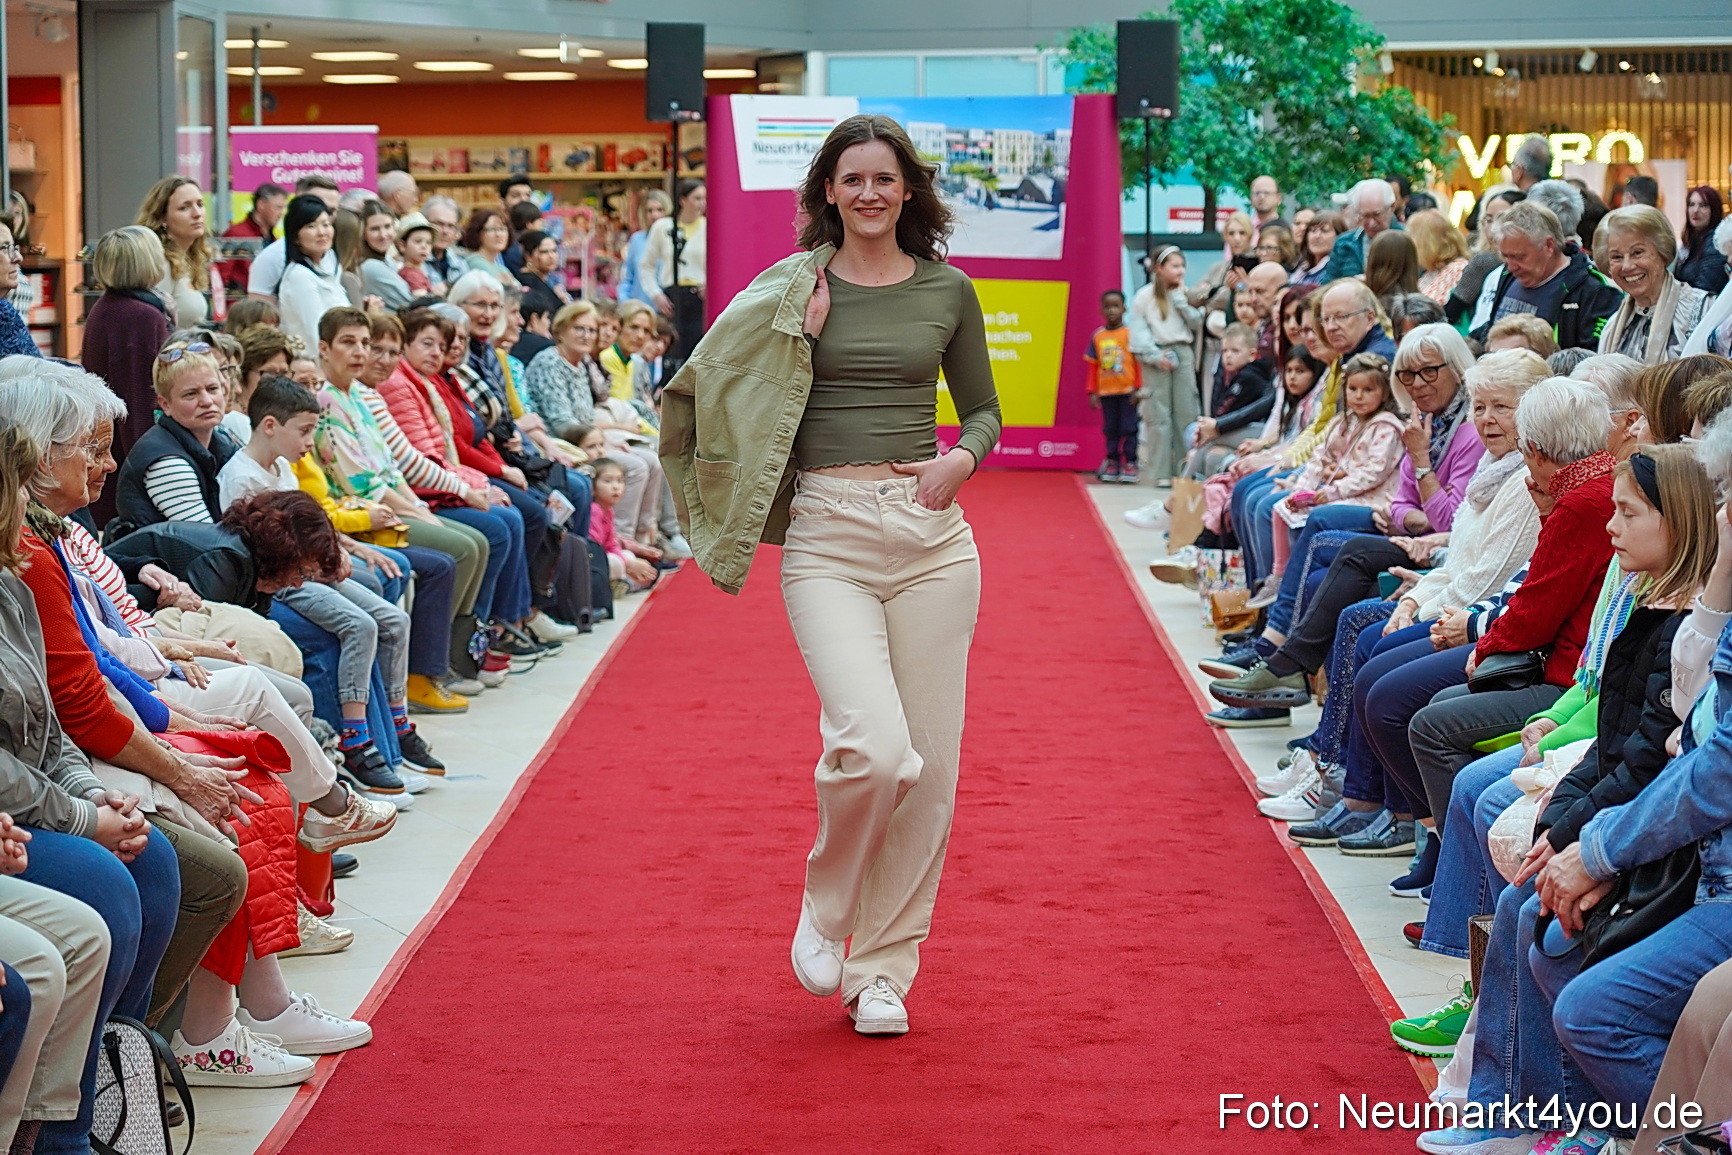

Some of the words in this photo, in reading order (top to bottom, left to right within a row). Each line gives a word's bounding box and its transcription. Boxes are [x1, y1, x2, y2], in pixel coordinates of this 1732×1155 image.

[239, 150, 337, 167] Verschenken
[338, 149, 363, 167] Sie
[996, 311, 1019, 326] Ort
